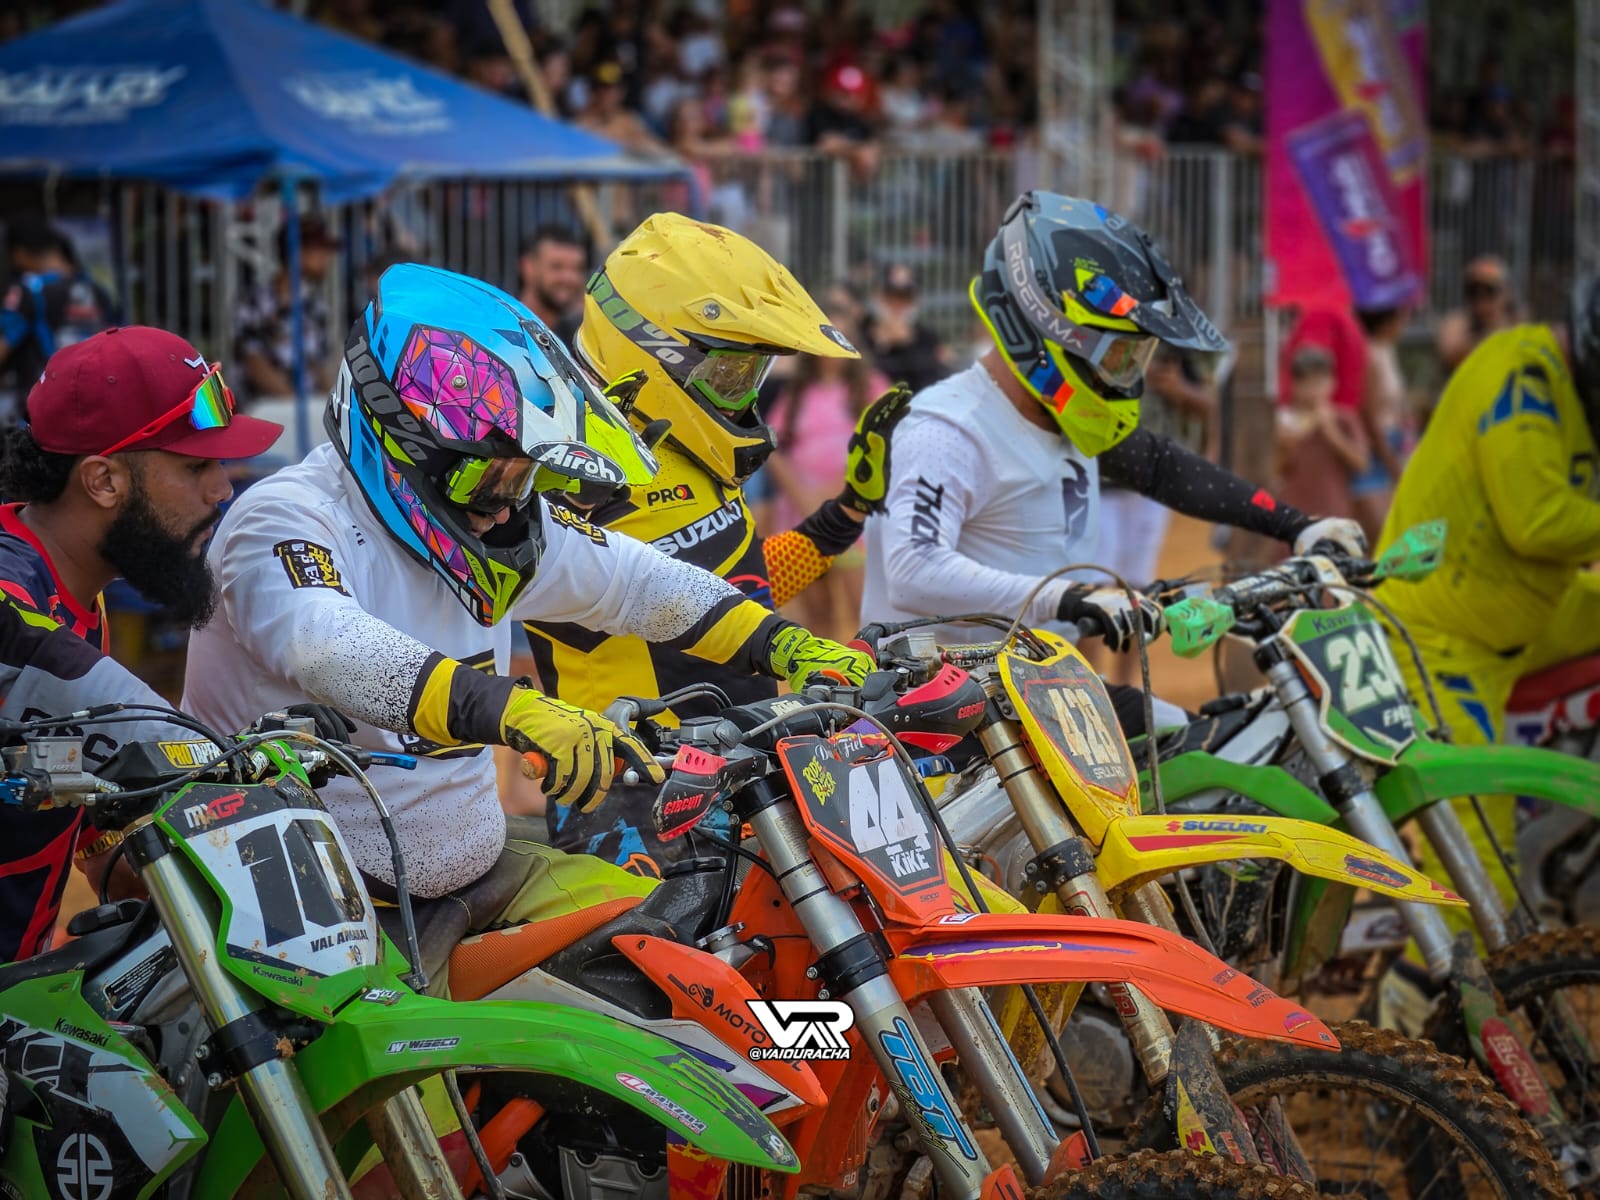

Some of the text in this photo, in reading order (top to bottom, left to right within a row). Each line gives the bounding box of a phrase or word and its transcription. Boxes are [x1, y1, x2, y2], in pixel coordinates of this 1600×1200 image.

[586, 271, 689, 364] 00%
[346, 335, 440, 461] 100%
[537, 444, 617, 482] Airoh
[652, 501, 742, 557] SUZUK
[663, 793, 704, 815] CIRCUIT
[849, 758, 931, 854] 44
[1182, 821, 1267, 834] SUZUKI
[235, 819, 366, 948] 10
[310, 936, 334, 953] VAL
[253, 965, 303, 987] Kawasaki
[54, 1017, 112, 1048] Kawasaki
[713, 1003, 767, 1044] MOTO
